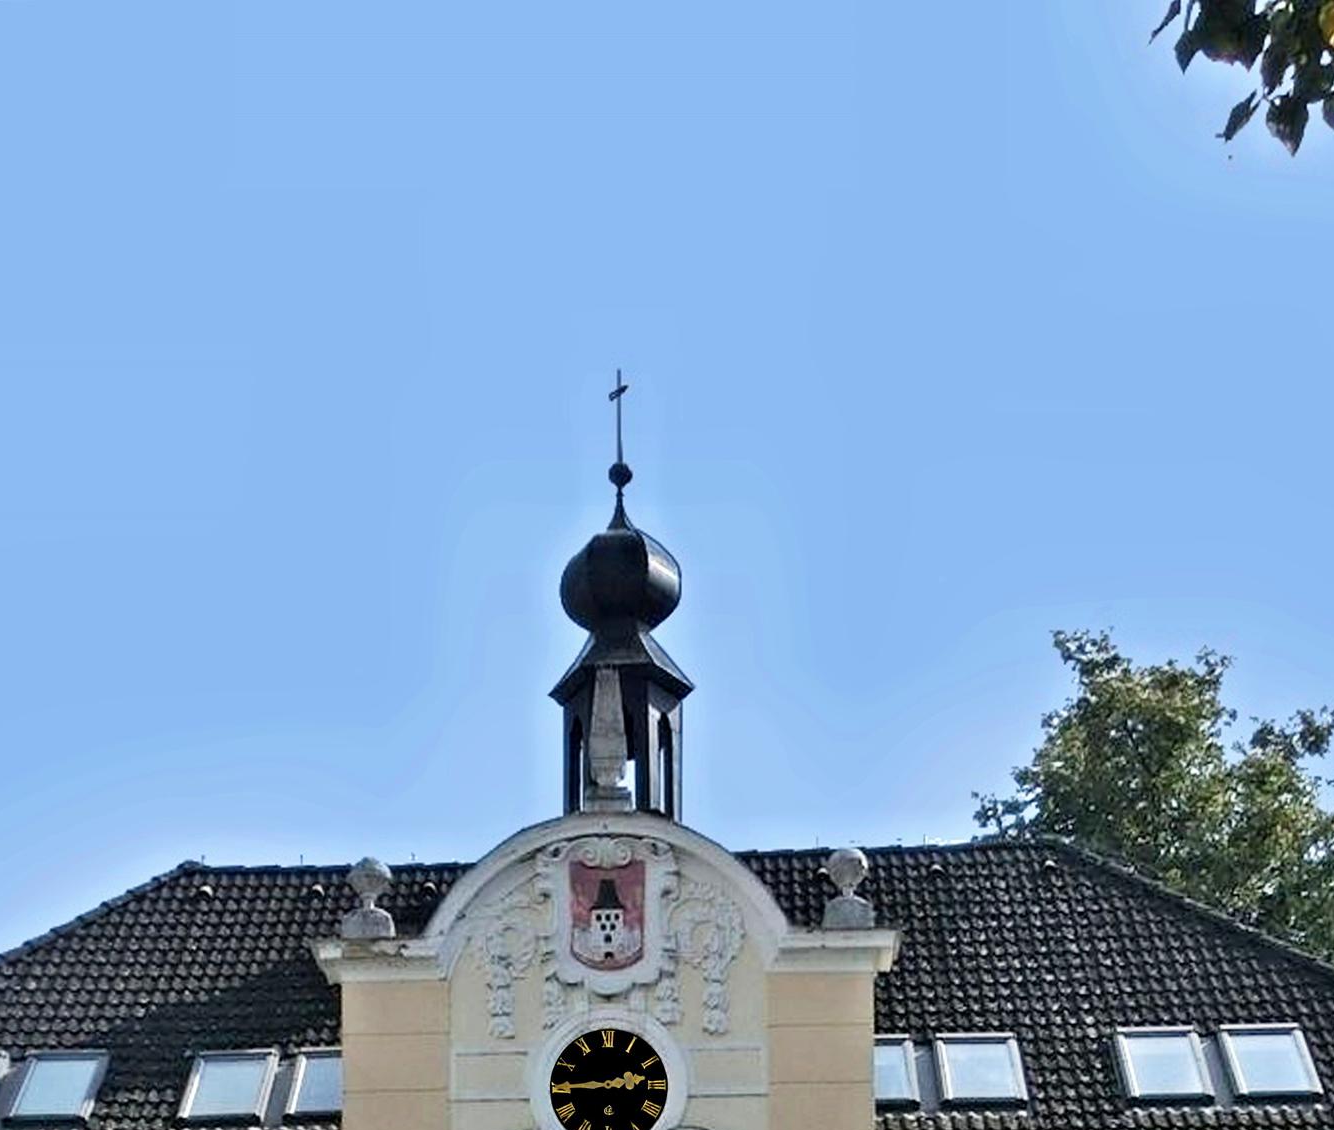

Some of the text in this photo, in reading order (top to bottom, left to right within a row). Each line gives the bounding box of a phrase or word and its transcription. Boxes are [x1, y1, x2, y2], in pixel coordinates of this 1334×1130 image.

[575, 1037, 591, 1056] XI
[601, 1030, 615, 1048] XII
[557, 1057, 576, 1072] X
[641, 1055, 659, 1069] II
[647, 1079, 666, 1090] III
[556, 1102, 576, 1123] VIII
[642, 1099, 662, 1118] IIII
